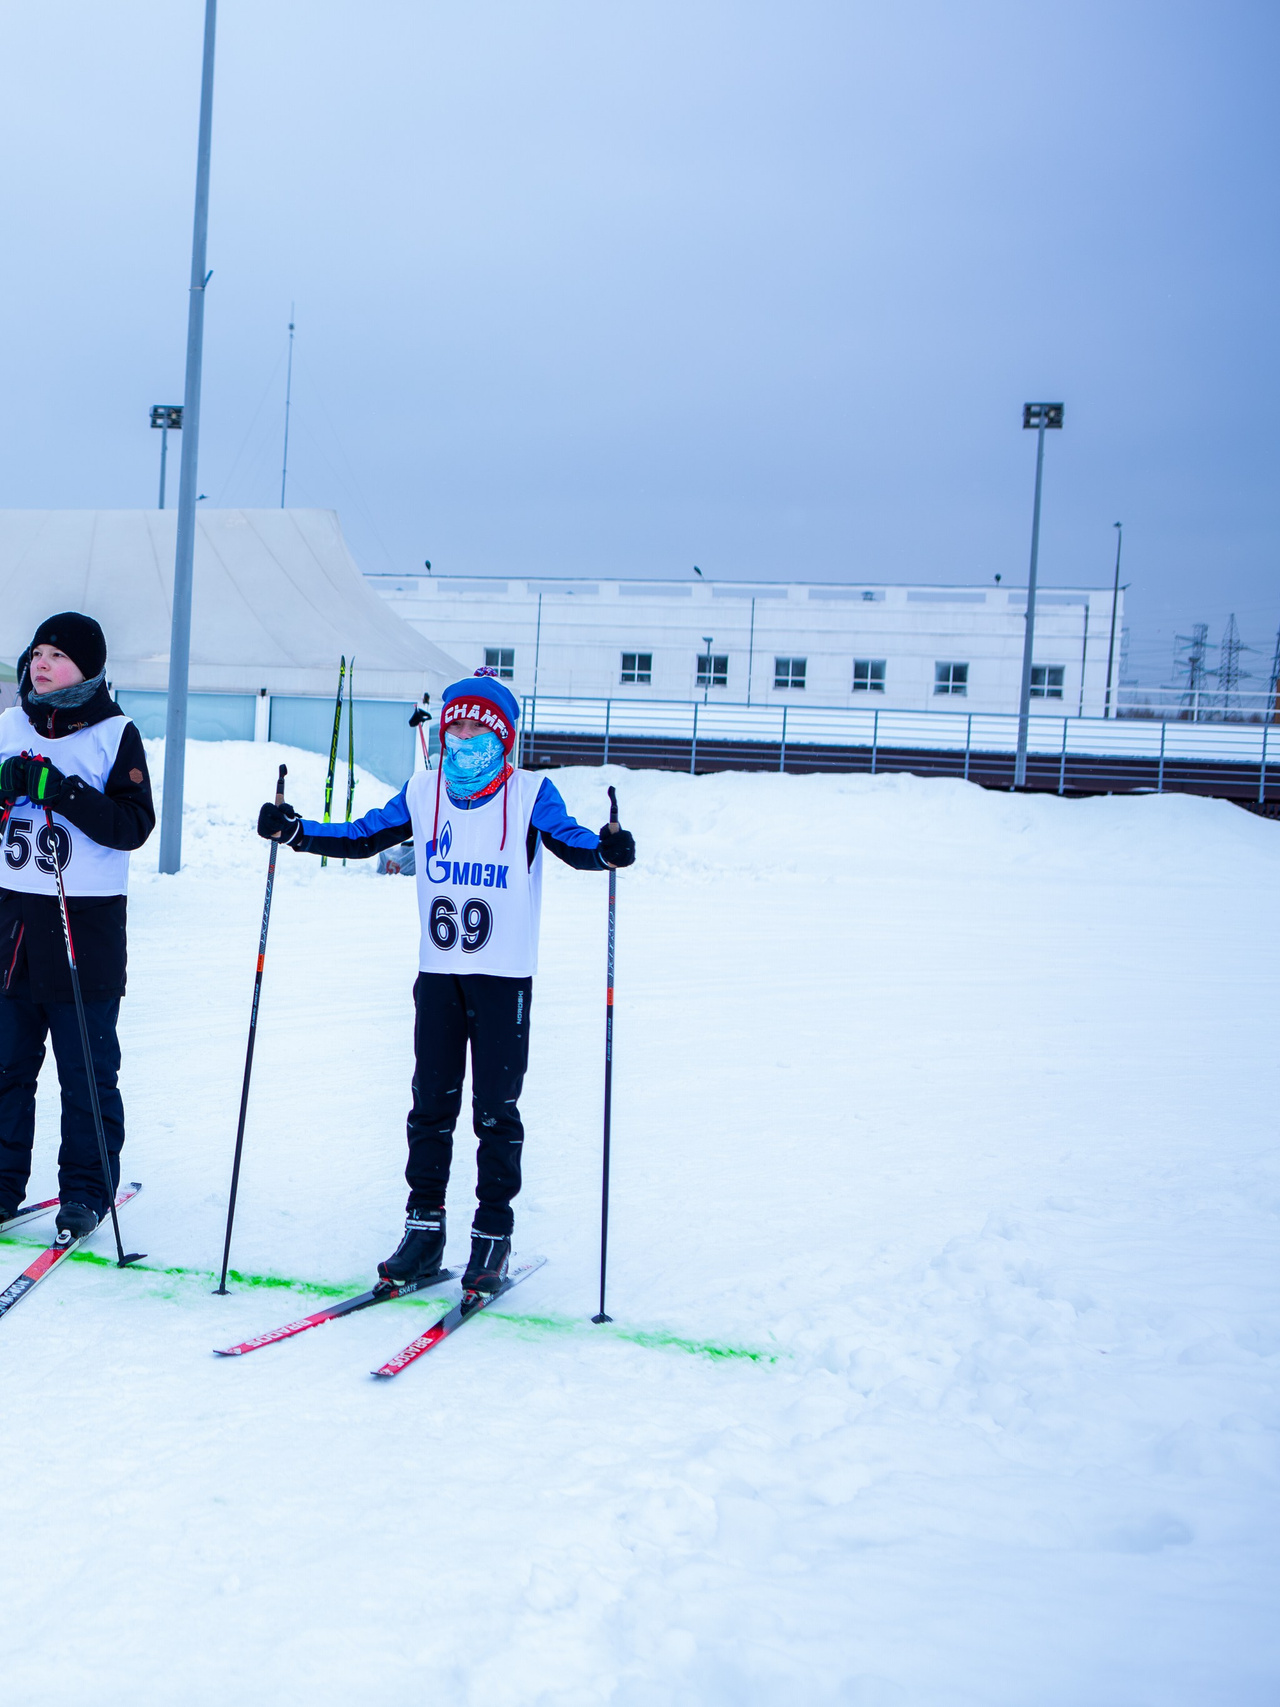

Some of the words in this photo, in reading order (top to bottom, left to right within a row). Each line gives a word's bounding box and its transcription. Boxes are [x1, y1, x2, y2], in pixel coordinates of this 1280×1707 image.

[4, 817, 72, 875] 59
[452, 861, 509, 889] МОЭК
[428, 895, 493, 954] 69
[398, 1283, 417, 1296] SKATE
[246, 1319, 312, 1347] BRADOS
[388, 1337, 433, 1368] BRADOS
